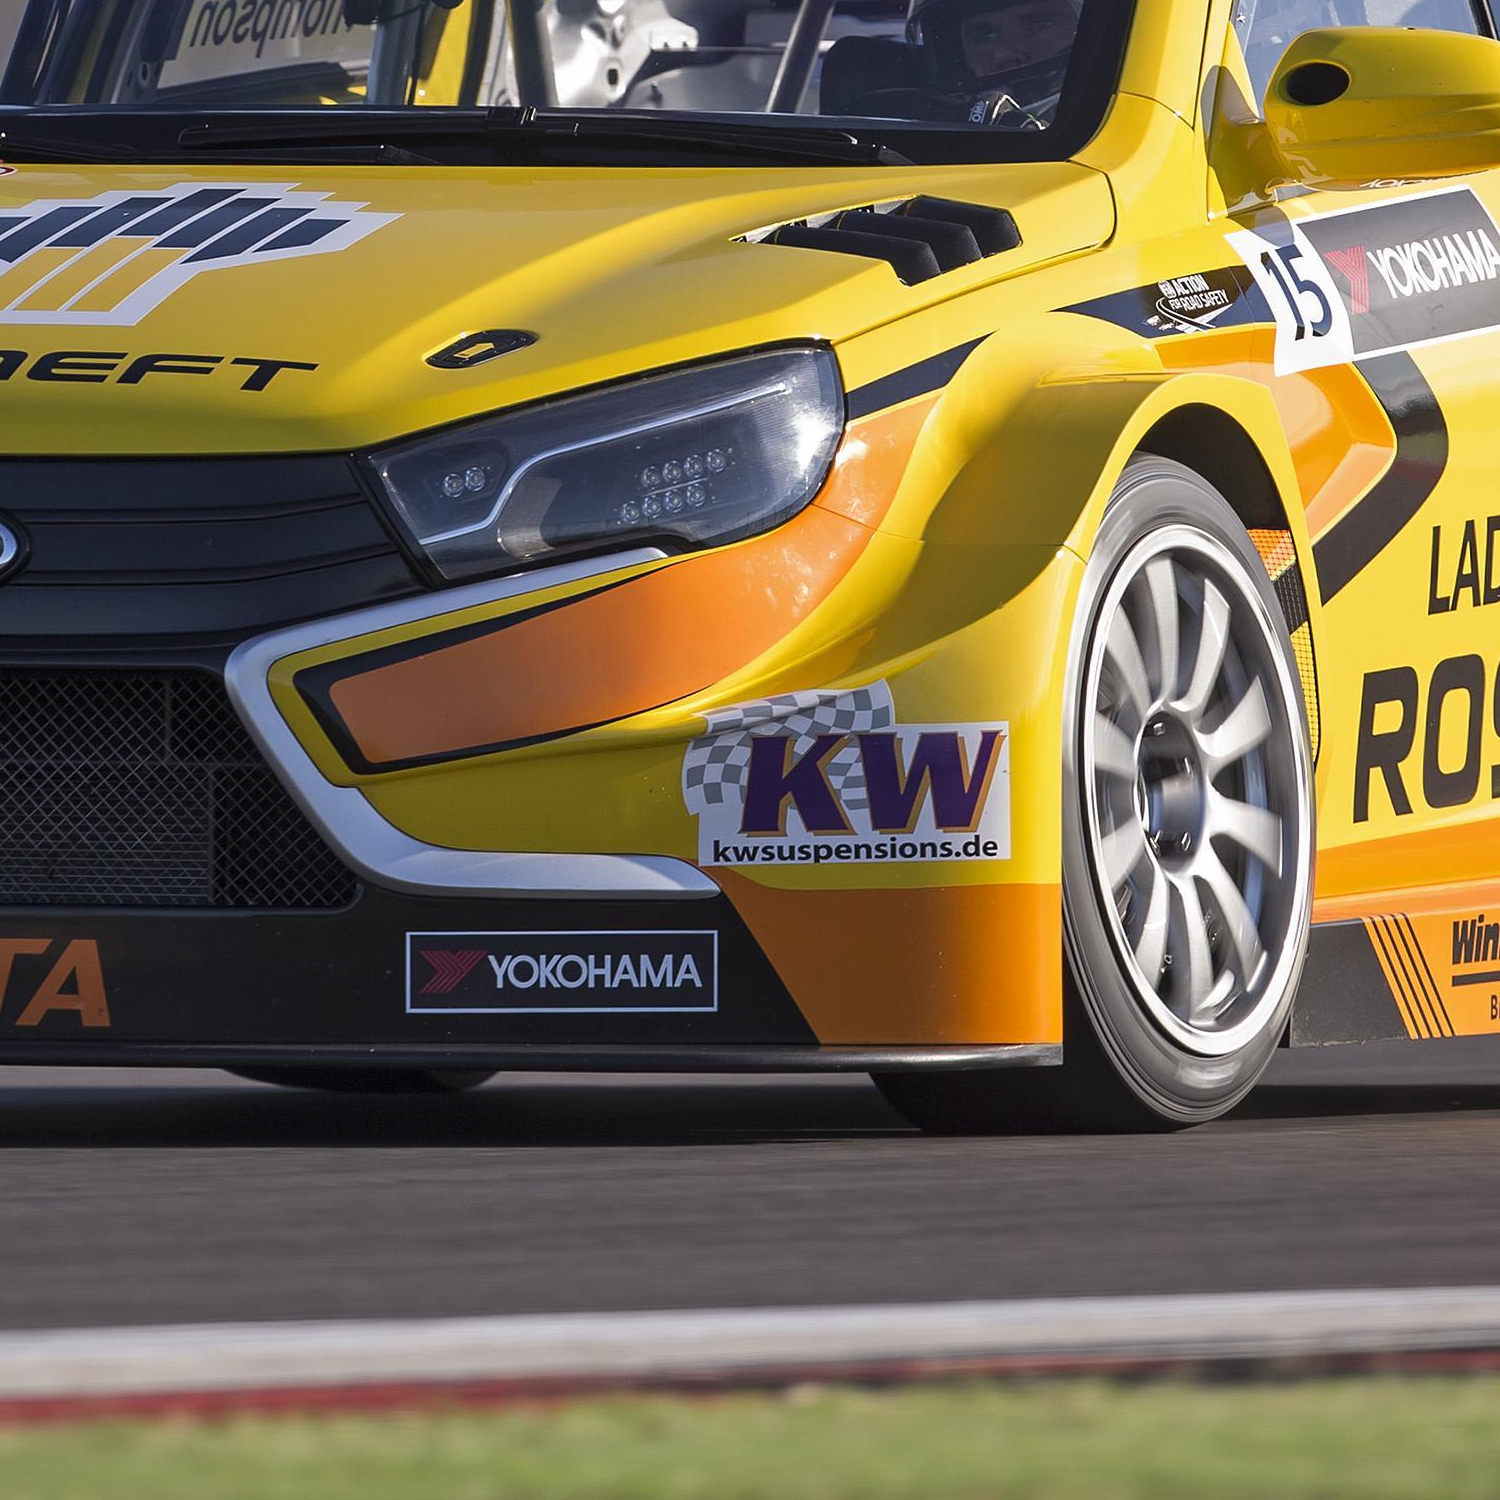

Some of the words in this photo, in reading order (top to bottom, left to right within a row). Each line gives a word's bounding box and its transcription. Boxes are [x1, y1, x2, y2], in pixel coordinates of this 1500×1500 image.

[1171, 274, 1209, 297] ACTION
[1200, 289, 1229, 308] SAFETY
[1259, 244, 1332, 341] 15
[738, 730, 1006, 836] KW
[713, 836, 998, 863] kwsuspensions.de
[488, 954, 702, 989] YOKOHAMA
